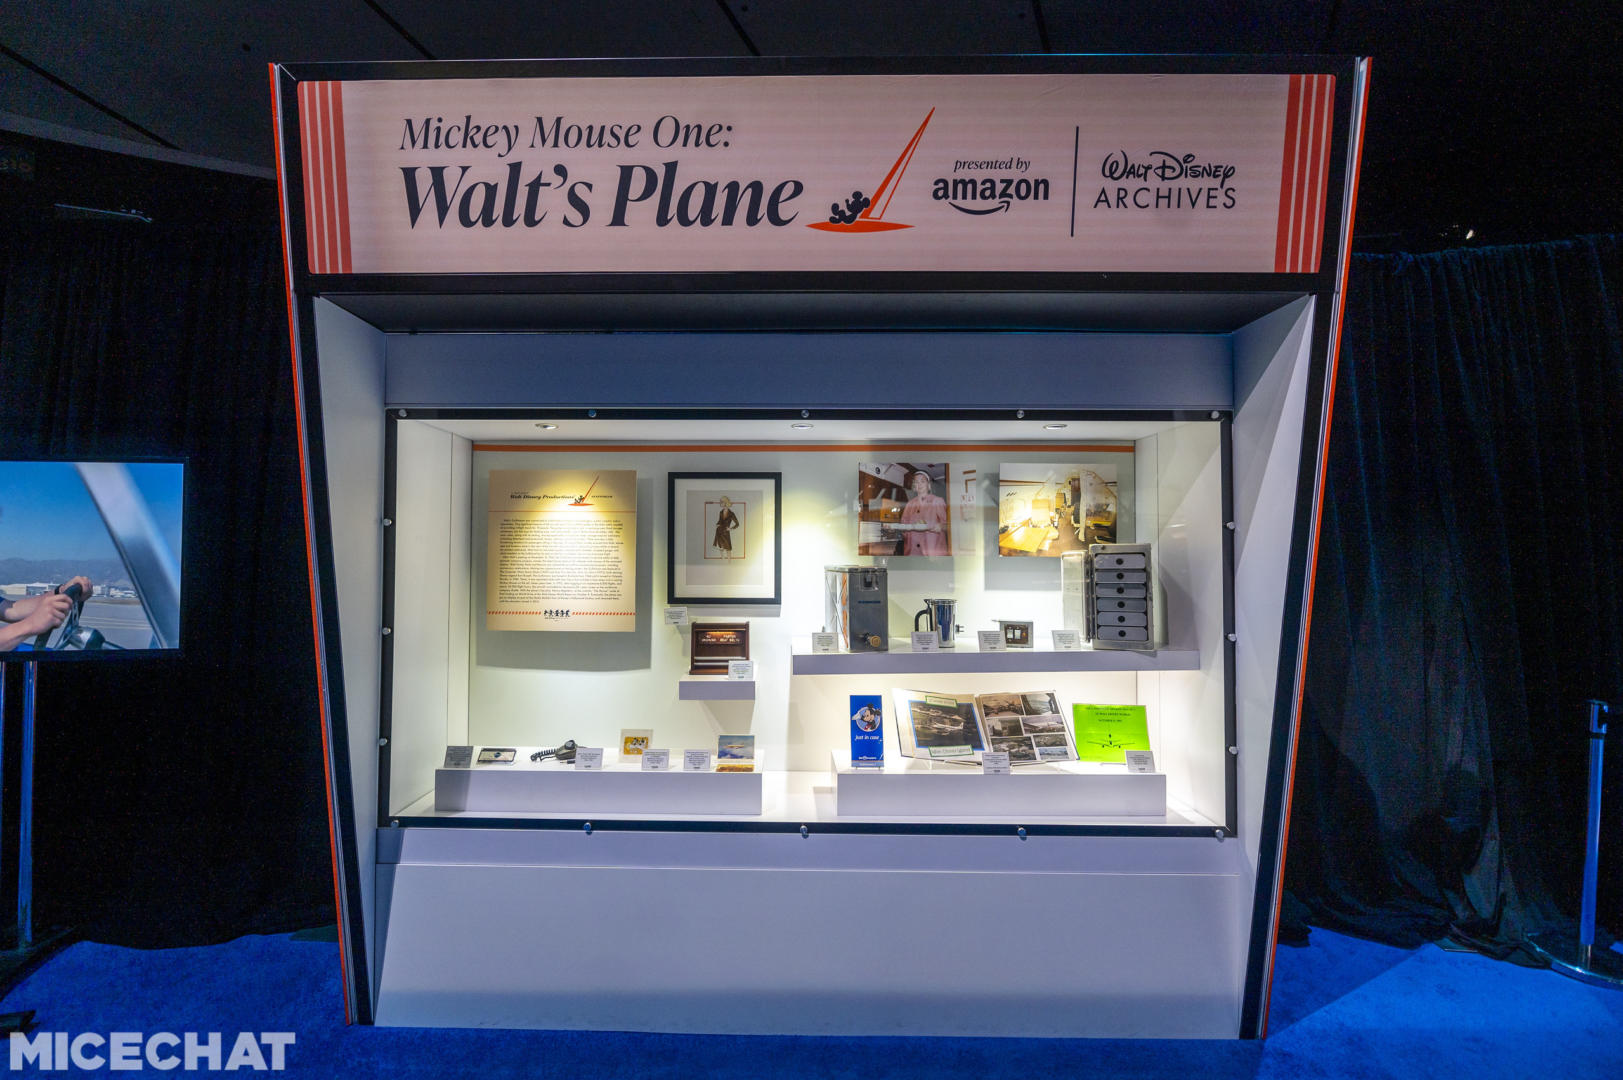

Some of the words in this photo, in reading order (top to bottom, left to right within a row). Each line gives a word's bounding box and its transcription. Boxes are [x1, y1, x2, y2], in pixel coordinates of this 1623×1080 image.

[400, 115, 519, 157] Mickey
[529, 116, 642, 149] Mouse
[652, 115, 733, 148] One:
[954, 157, 1013, 173] presented
[1015, 157, 1031, 173] by
[400, 160, 593, 229] Walt's
[606, 160, 804, 228] Plane
[932, 178, 1050, 201] amazon
[1093, 187, 1236, 210] ARCHIVES
